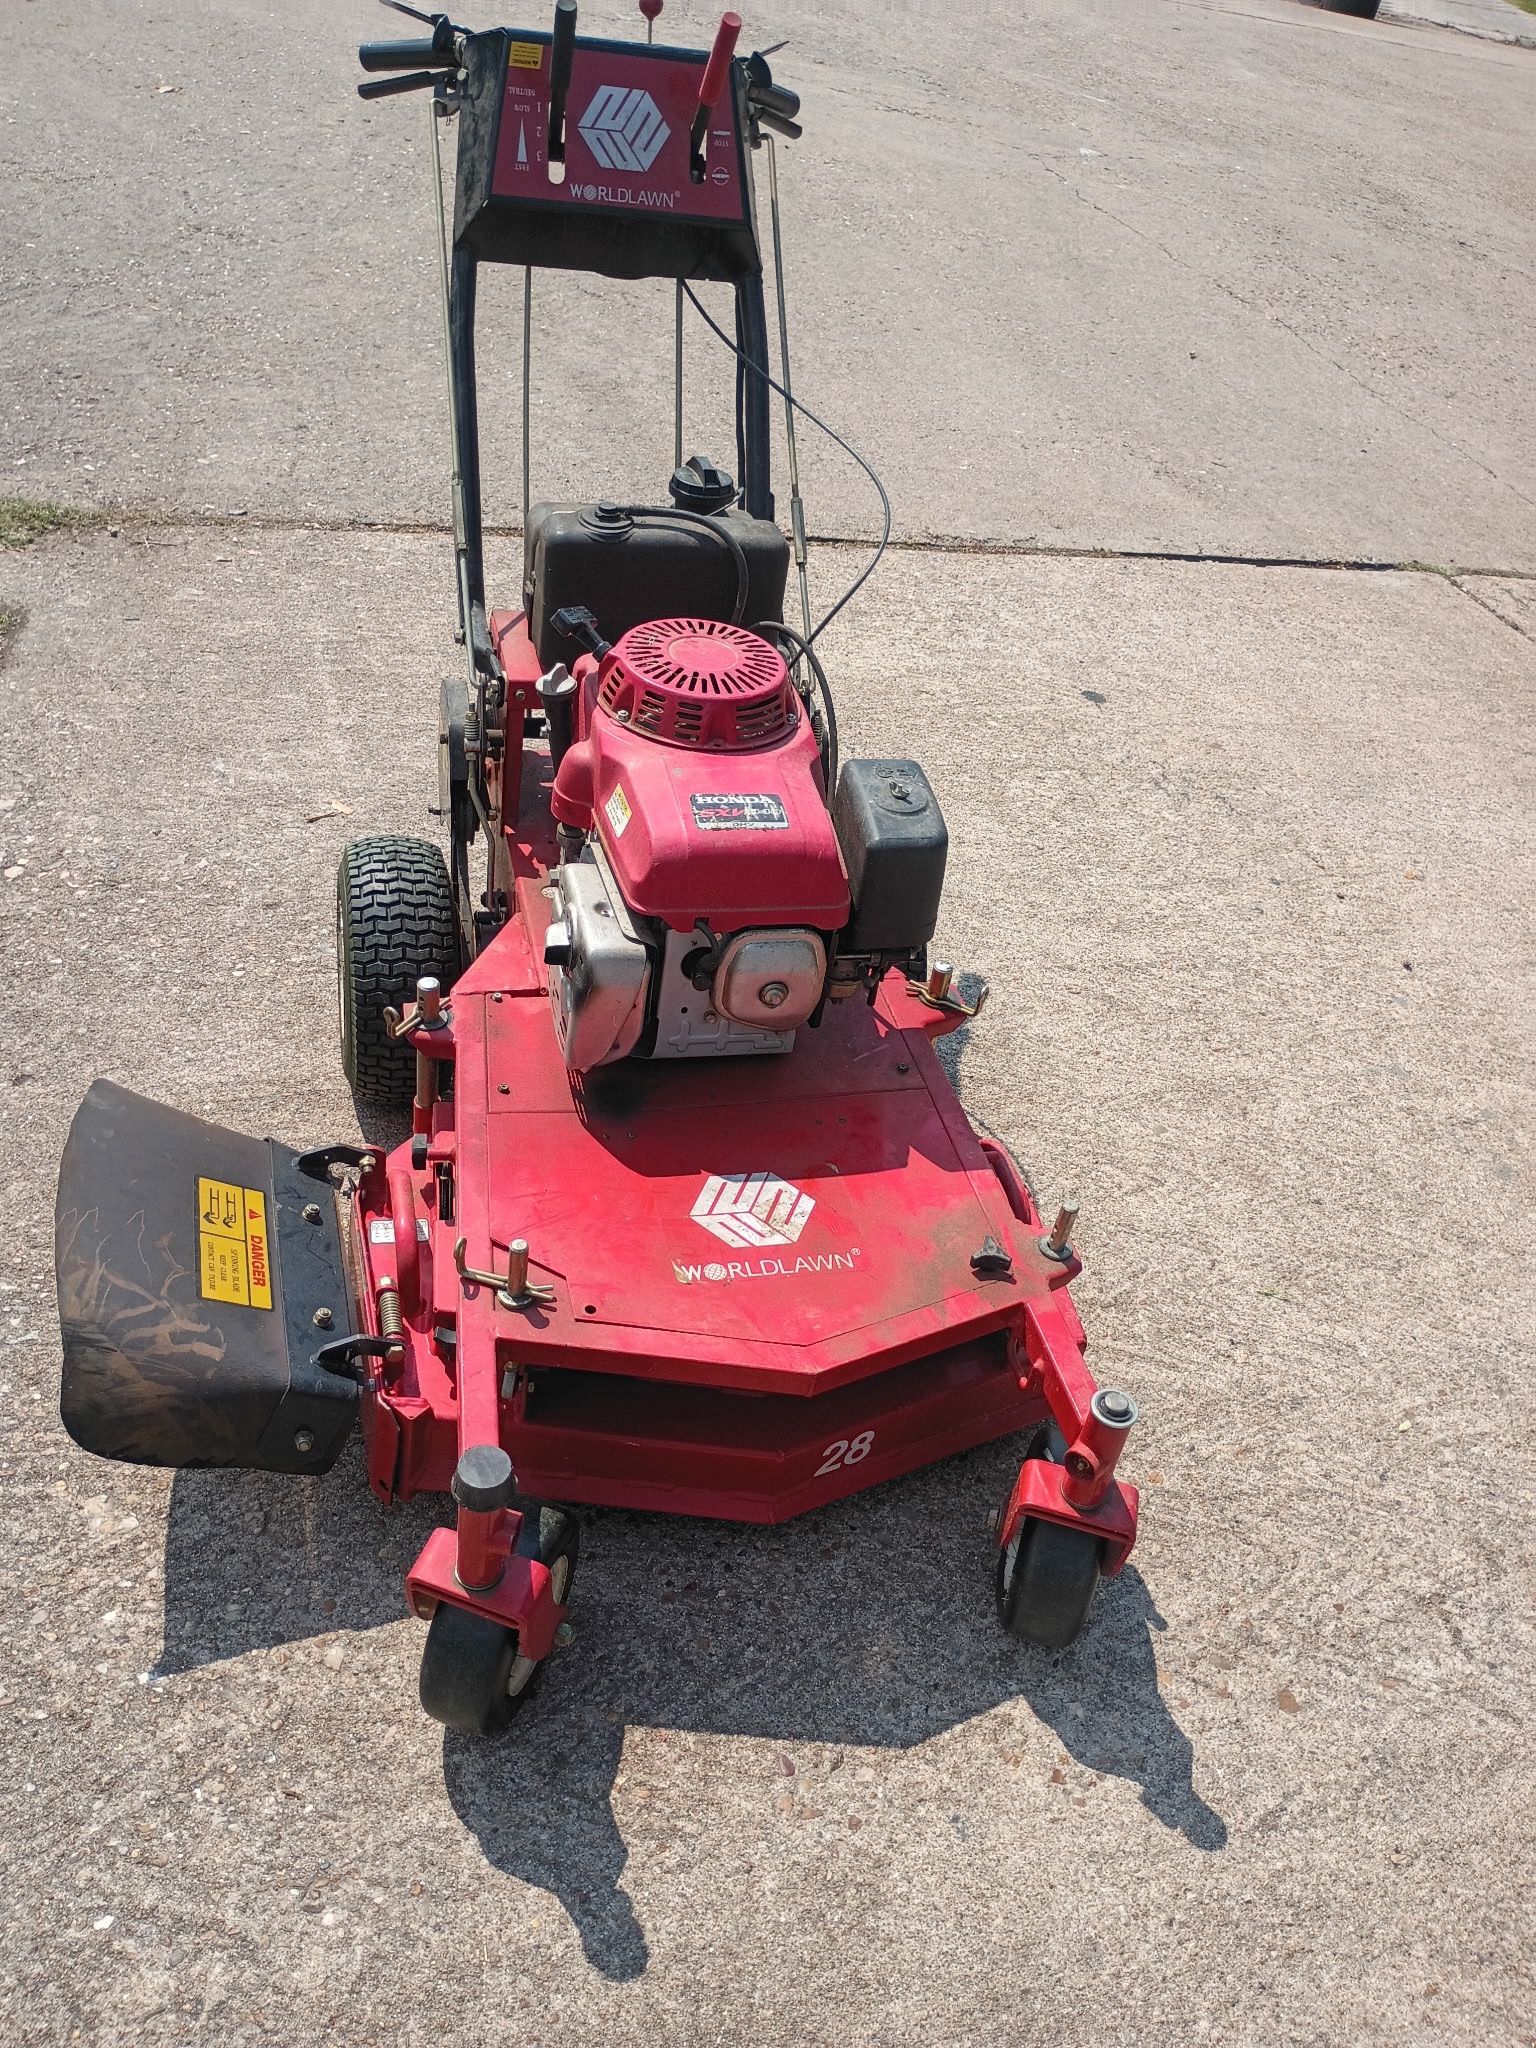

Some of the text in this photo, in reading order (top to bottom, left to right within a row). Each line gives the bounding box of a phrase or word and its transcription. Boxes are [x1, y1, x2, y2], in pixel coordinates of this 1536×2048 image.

[508, 86, 536, 96] NEUTRAL
[514, 104, 530, 112] SLOW
[536, 101, 541, 113] 1
[536, 126, 542, 137] 2
[536, 150, 542, 161] 3
[514, 163, 530, 171] FAST
[695, 795, 776, 804] HONDA
[250, 1235, 266, 1287] DANGER
[231, 1249, 240, 1293] SPINNING BLADE
[813, 1430, 876, 1478] 28
